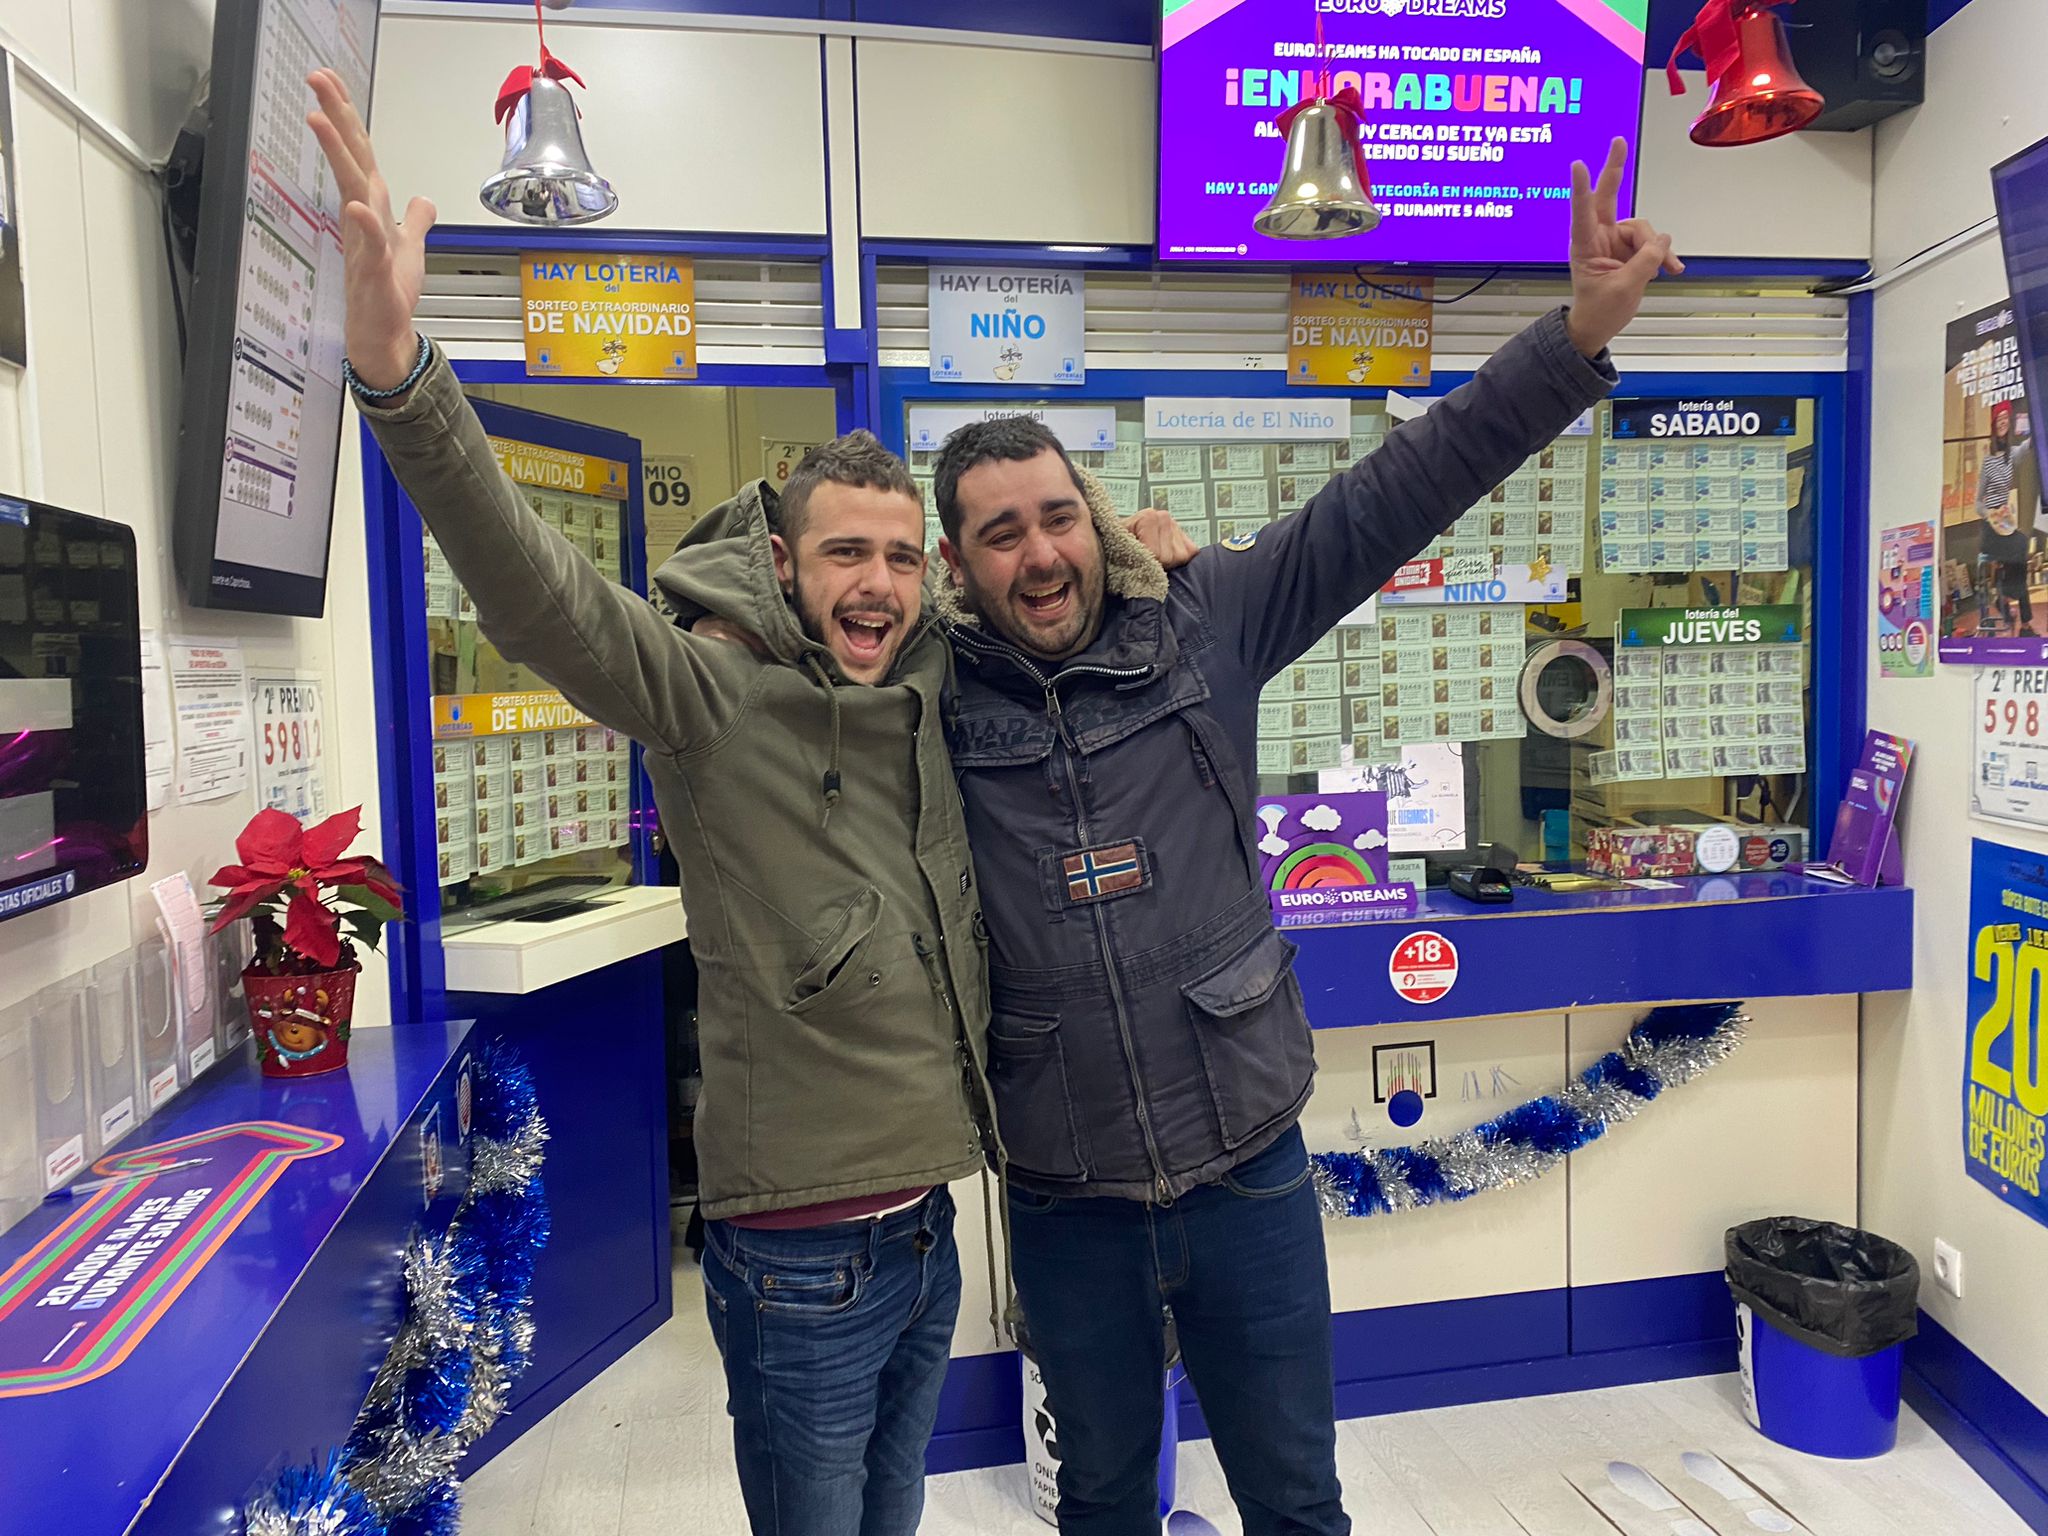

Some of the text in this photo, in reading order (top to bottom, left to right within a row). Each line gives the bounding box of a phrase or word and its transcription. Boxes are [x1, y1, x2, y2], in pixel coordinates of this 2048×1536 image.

[1406, 0, 1506, 17] DREAMS
[1378, 45, 1400, 60] HA
[1402, 46, 1460, 61] TOCADO
[1462, 47, 1482, 62] EN
[1484, 46, 1541, 63] ESPAÑA
[1379, 124, 1434, 141] CERCA
[1437, 125, 1460, 141] DE
[1462, 126, 1483, 141] TI
[1484, 126, 1508, 143] YA
[1510, 123, 1552, 143] ESTÁ
[1421, 144, 1445, 161] SU
[1446, 143, 1504, 162] SUEÑO
[1206, 182, 1235, 195] HAY
[1237, 182, 1246, 195] 1
[1371, 181, 1439, 198] ATEGORÍA
[1442, 186, 1461, 198] EN
[1463, 186, 1524, 200] MADRID,
[1526, 187, 1542, 200] ¡Y
[1394, 203, 1462, 217] DURANTE
[1463, 204, 1473, 217] 5
[1475, 202, 1514, 218] AÑOS
[533, 261, 681, 283] HAY LOTERÍA
[604, 283, 620, 293] del
[940, 273, 1073, 295] HAY LOTERÍA
[1300, 281, 1424, 300] HAY LOTERÍA
[527, 300, 690, 313] SORTEO EXTRAORDINARIO
[1004, 295, 1018, 304] del
[1359, 301, 1373, 309] del
[528, 312, 692, 336] DE NAVIDAD
[971, 308, 1046, 340] NIÑO
[1293, 316, 1429, 328] SORTEO EXTRAORDINARIO
[1292, 327, 1429, 348] DE NAVIDAD
[1678, 400, 1733, 412] lotería del
[1156, 410, 1334, 428] Lotería de El Niño
[1650, 412, 1760, 437] SABADO
[517, 444, 585, 467] EXTRAORDINARIO
[511, 456, 585, 489] NAVIDAD
[1685, 608, 1739, 620] lotería del
[1662, 620, 1761, 644] JUEVES
[279, 687, 315, 714] PREMIO
[492, 694, 527, 707] SORTEO
[492, 708, 517, 731] DE
[264, 719, 322, 765] 59812
[1392, 863, 1421, 871] TARJETA
[21, 879, 63, 905] OFICIALES
[1280, 887, 1408, 907] EURO DREAMS
[1404, 939, 1442, 963] +18
[1970, 924, 2048, 1116] 20
[1969, 1084, 2046, 1161] MILLONES
[1969, 1121, 2040, 1197] DE EUROS
[123, 1196, 172, 1224] MES
[105, 1222, 147, 1241] AL
[68, 1187, 213, 1311] DURANTE 30 AÑOS
